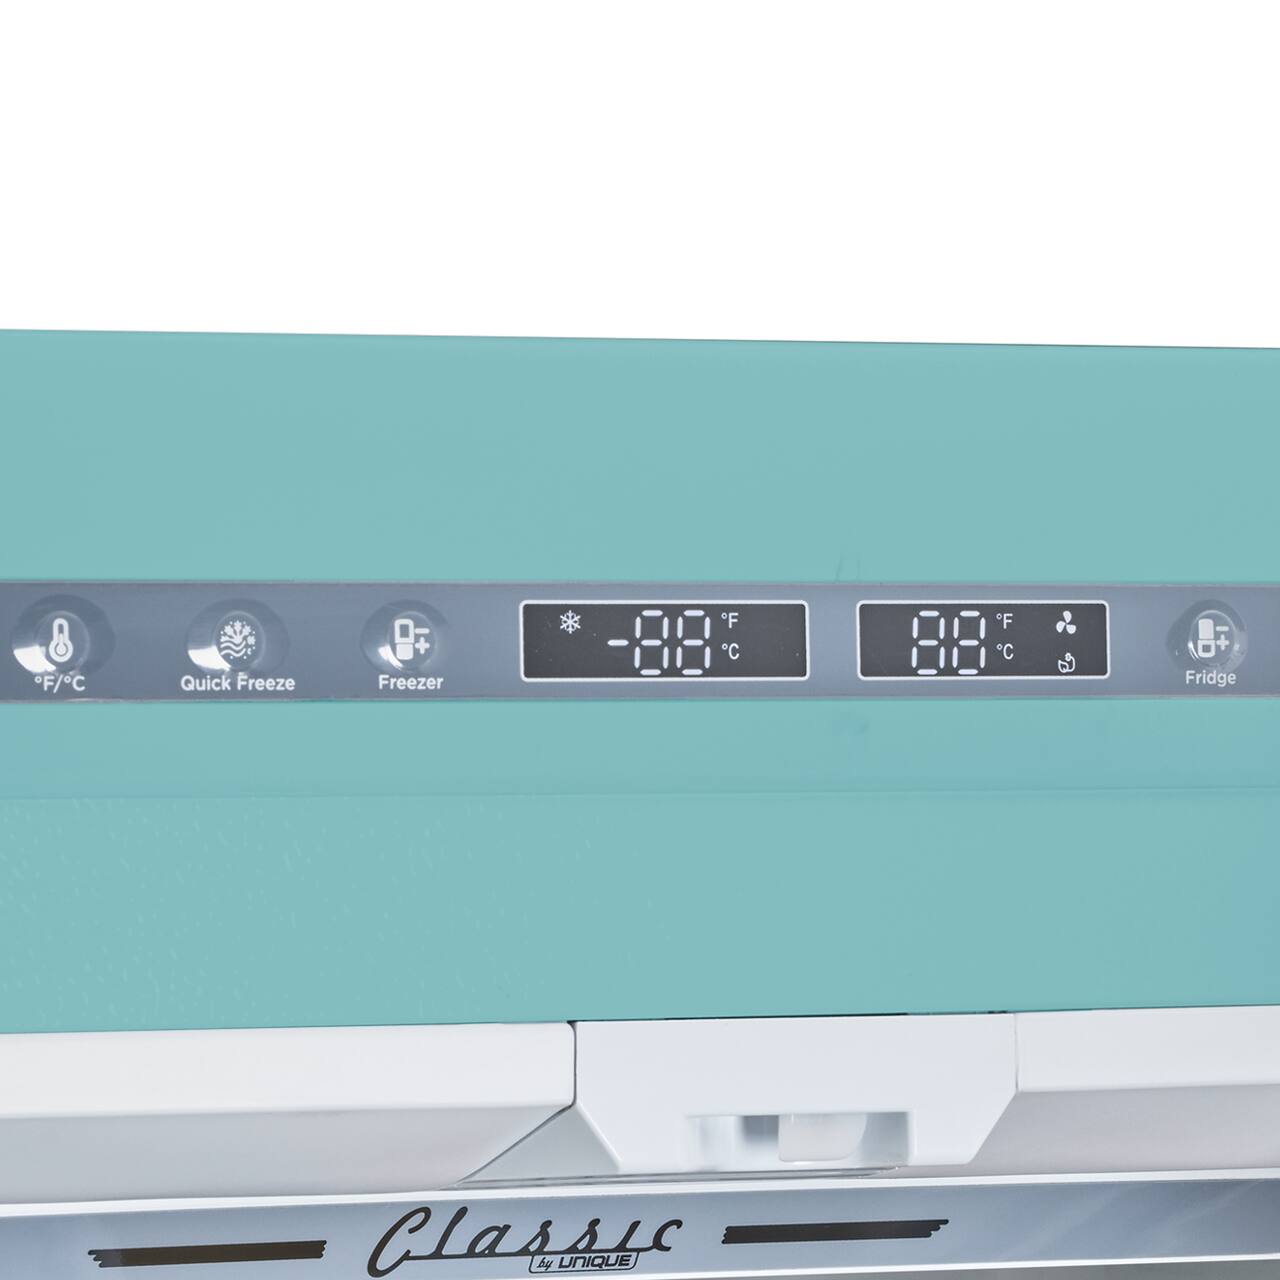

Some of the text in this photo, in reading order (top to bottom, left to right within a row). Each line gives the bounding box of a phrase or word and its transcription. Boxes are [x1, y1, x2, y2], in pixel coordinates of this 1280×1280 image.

[721, 611, 740, 630] °F
[996, 611, 1014, 630] °F
[721, 643, 741, 662] °C
[911, 610, 987, 676] 88
[996, 643, 1015, 662] °C
[34, 675, 86, 692] °F/°C
[180, 674, 296, 692] Quick Freeze
[378, 674, 444, 691] Freezer
[1185, 670, 1237, 687] Fridge
[367, 1205, 684, 1278] Classic
[536, 1254, 632, 1271] by UNIQUE
